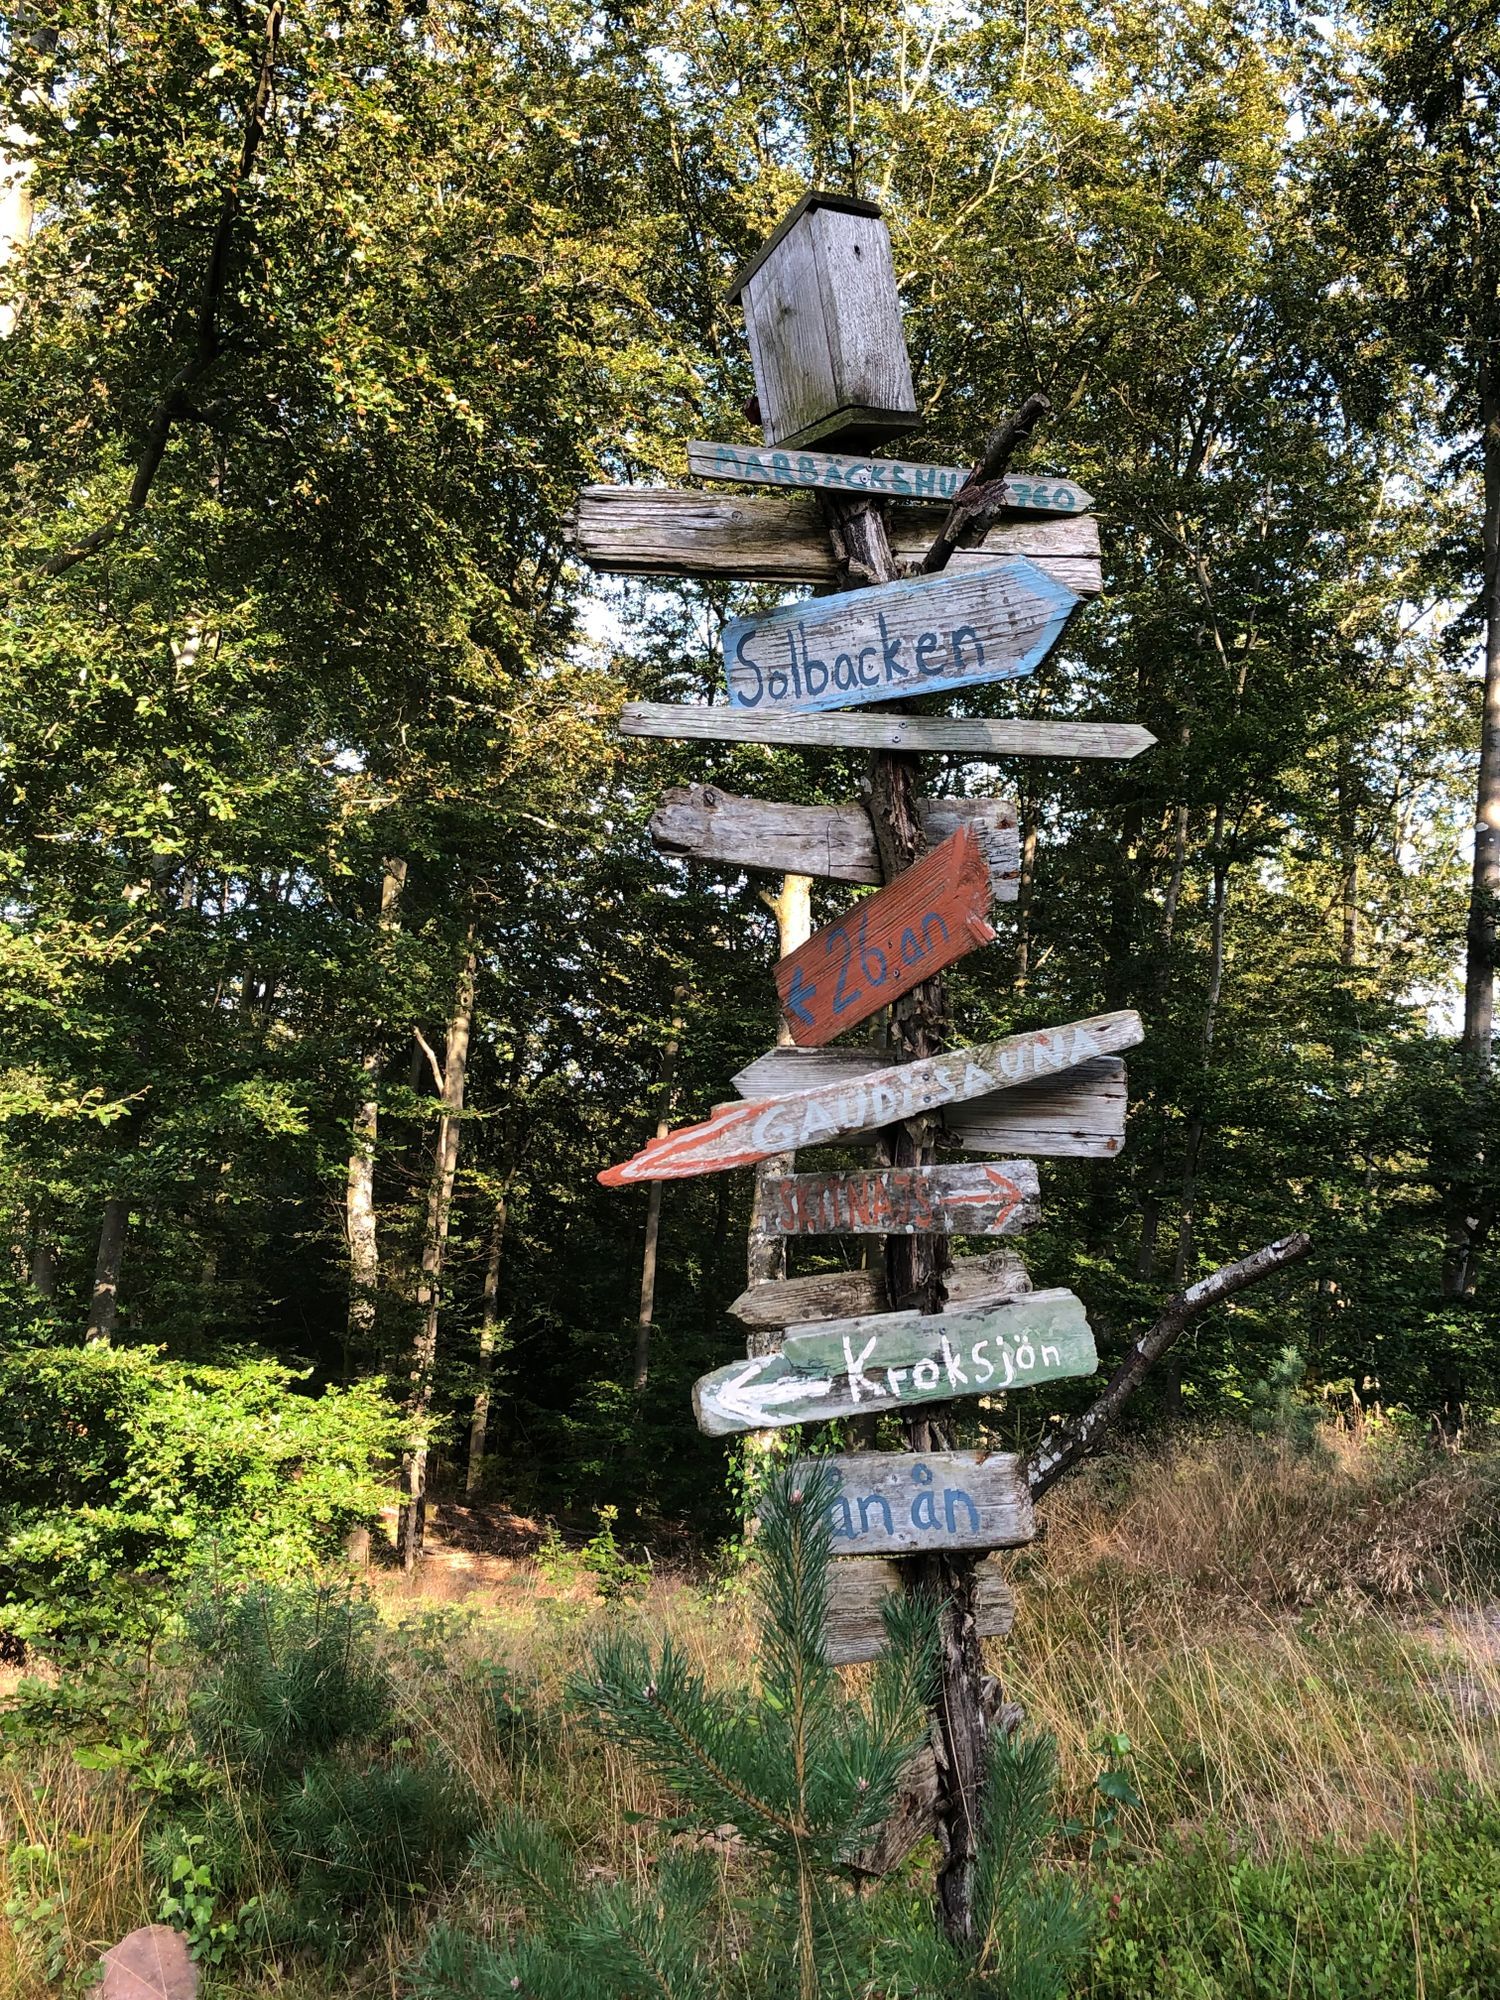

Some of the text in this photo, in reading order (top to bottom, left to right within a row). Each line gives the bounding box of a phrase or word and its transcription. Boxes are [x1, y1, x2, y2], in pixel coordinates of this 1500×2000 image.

[1011, 483, 1075, 512] 760
[736, 612, 985, 707] Solbacken
[843, 1333, 1060, 1402] Kroksjön
